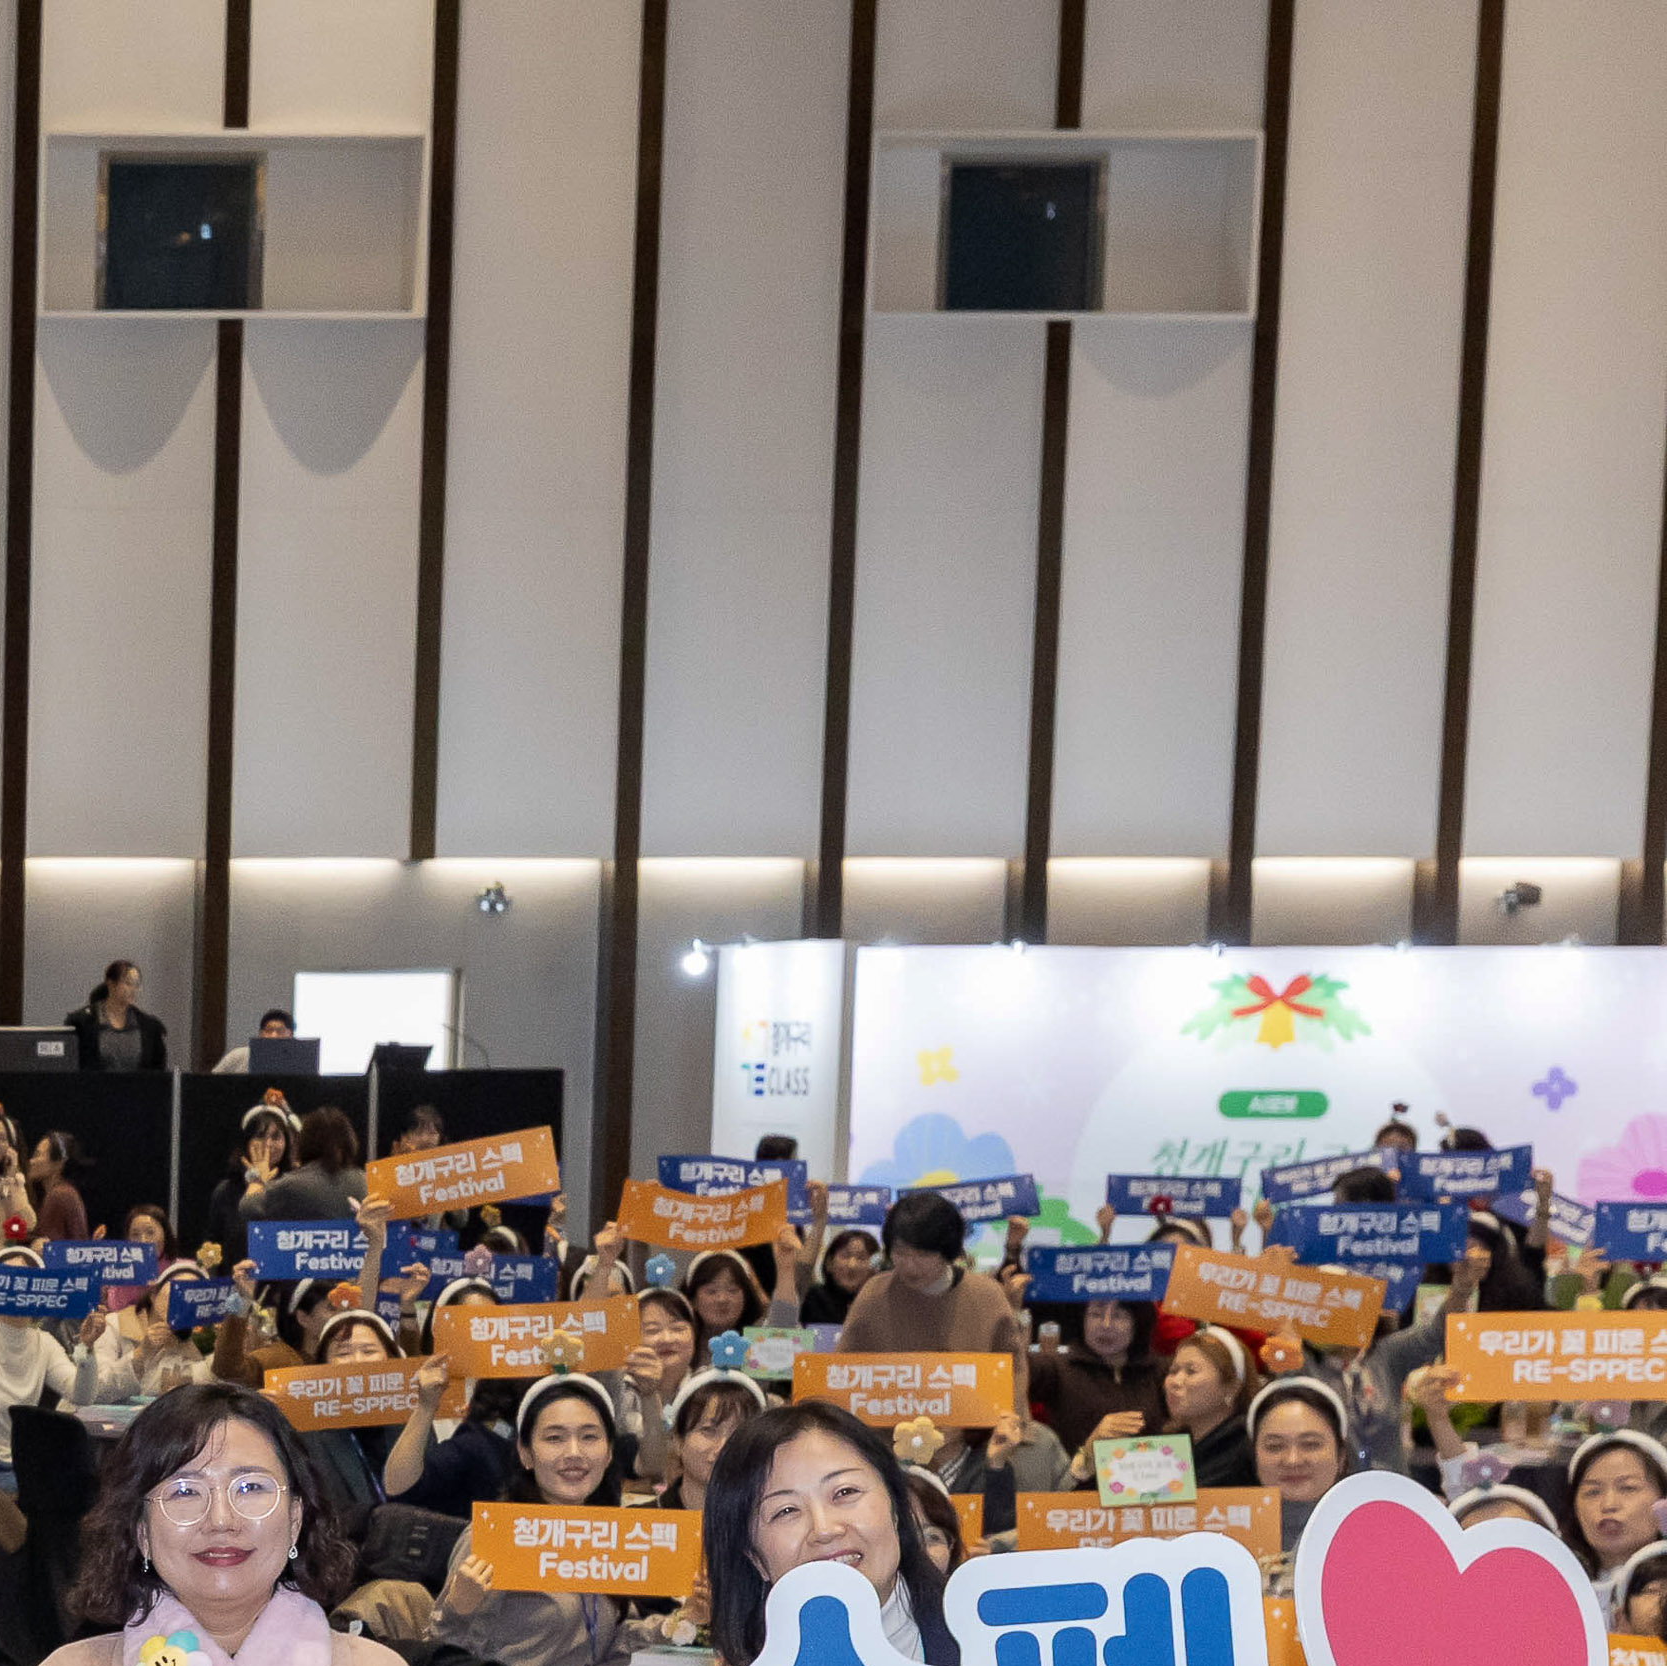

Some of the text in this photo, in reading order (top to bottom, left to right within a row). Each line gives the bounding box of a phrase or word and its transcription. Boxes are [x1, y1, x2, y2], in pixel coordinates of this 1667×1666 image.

[395, 1143, 523, 1187] 청개구리 스펙
[419, 1171, 505, 1205] Festival
[276, 1231, 348, 1250] 청개구리
[32, 1276, 59, 1291] 피운
[62, 1276, 88, 1292] 스펙
[470, 1311, 606, 1341] 청개구리 스펙
[1478, 1330, 1556, 1357] 우리가
[1593, 1328, 1644, 1354] 피운
[826, 1364, 976, 1390] 청개구리 스펙
[1512, 1358, 1665, 1384] RE-SPPEC
[288, 1380, 342, 1399] 우리가
[369, 1373, 404, 1392] 피운
[850, 1392, 951, 1416] Festival
[1046, 1505, 1251, 1533] 우리가 꽃 피운 스펙
[514, 1517, 677, 1552] 청개구리 스펙
[539, 1551, 648, 1581] Festival
